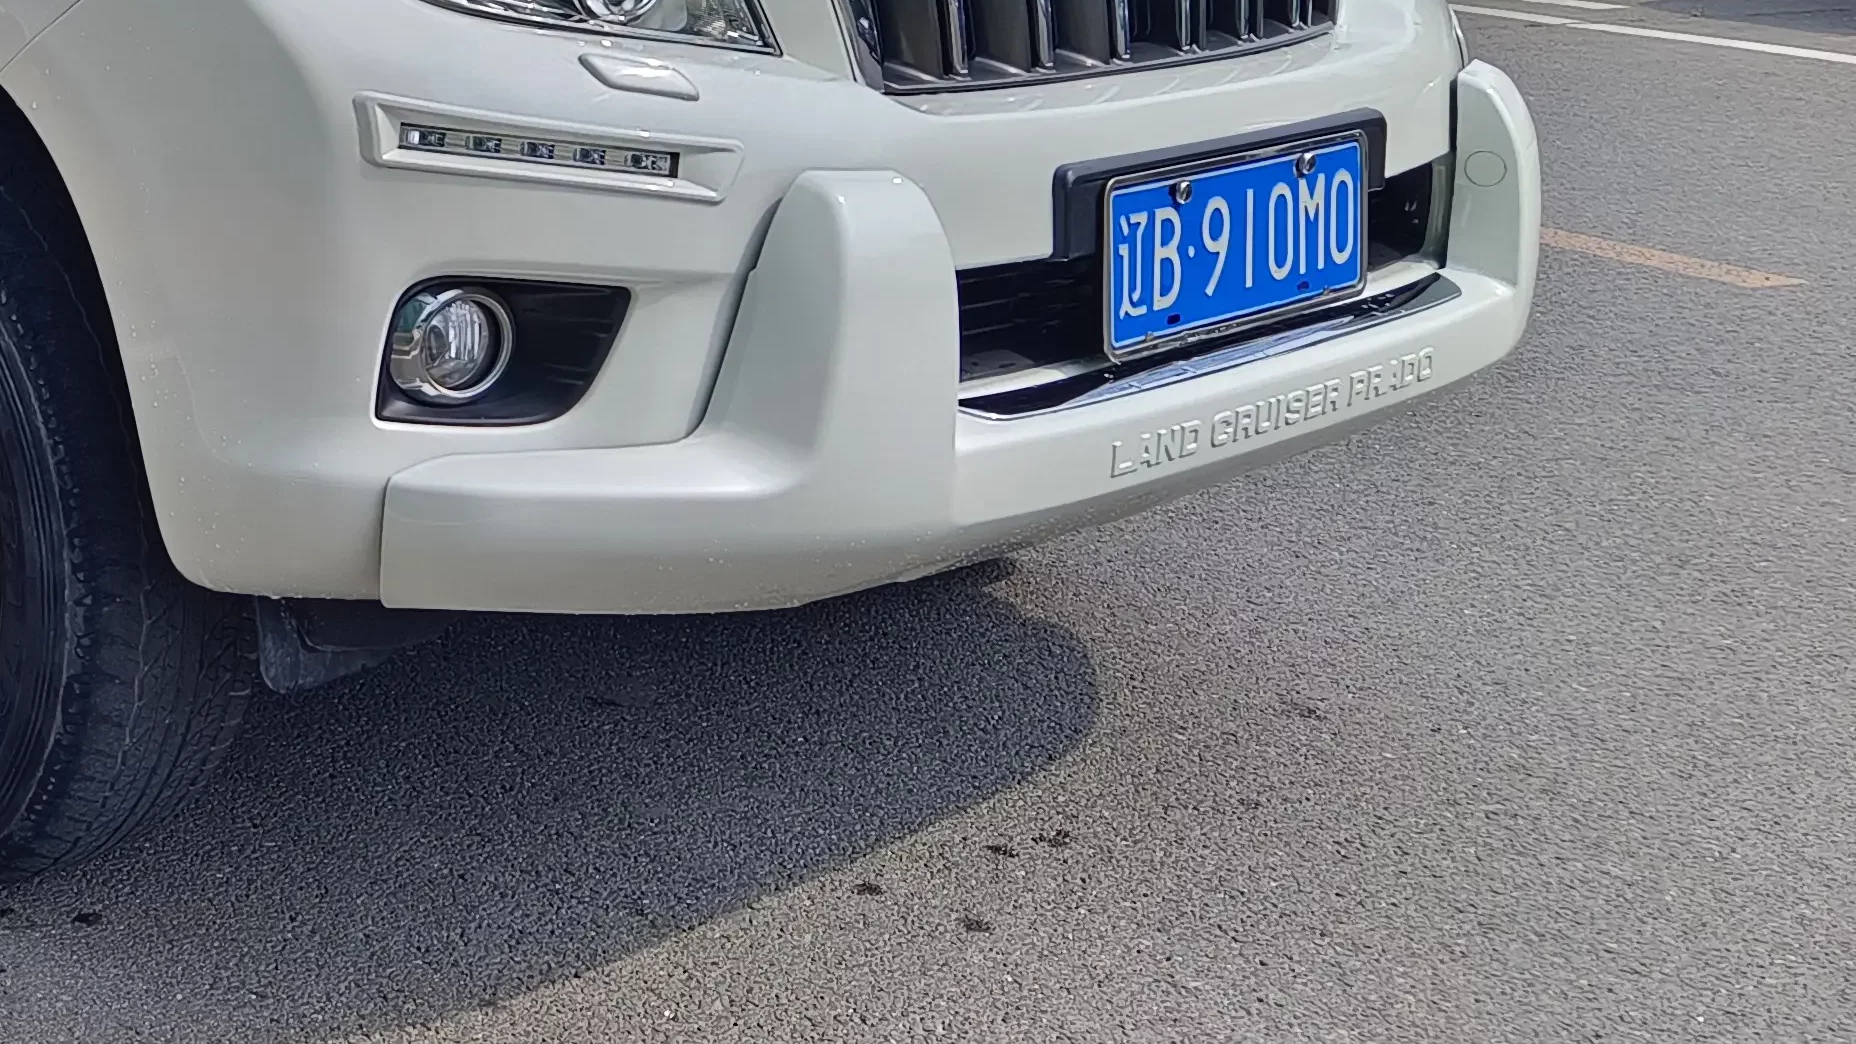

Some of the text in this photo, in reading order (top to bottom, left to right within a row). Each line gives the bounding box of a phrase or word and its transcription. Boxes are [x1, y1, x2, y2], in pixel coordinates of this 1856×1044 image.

[1110, 345, 1436, 479] LAND CRUISER PRADO
